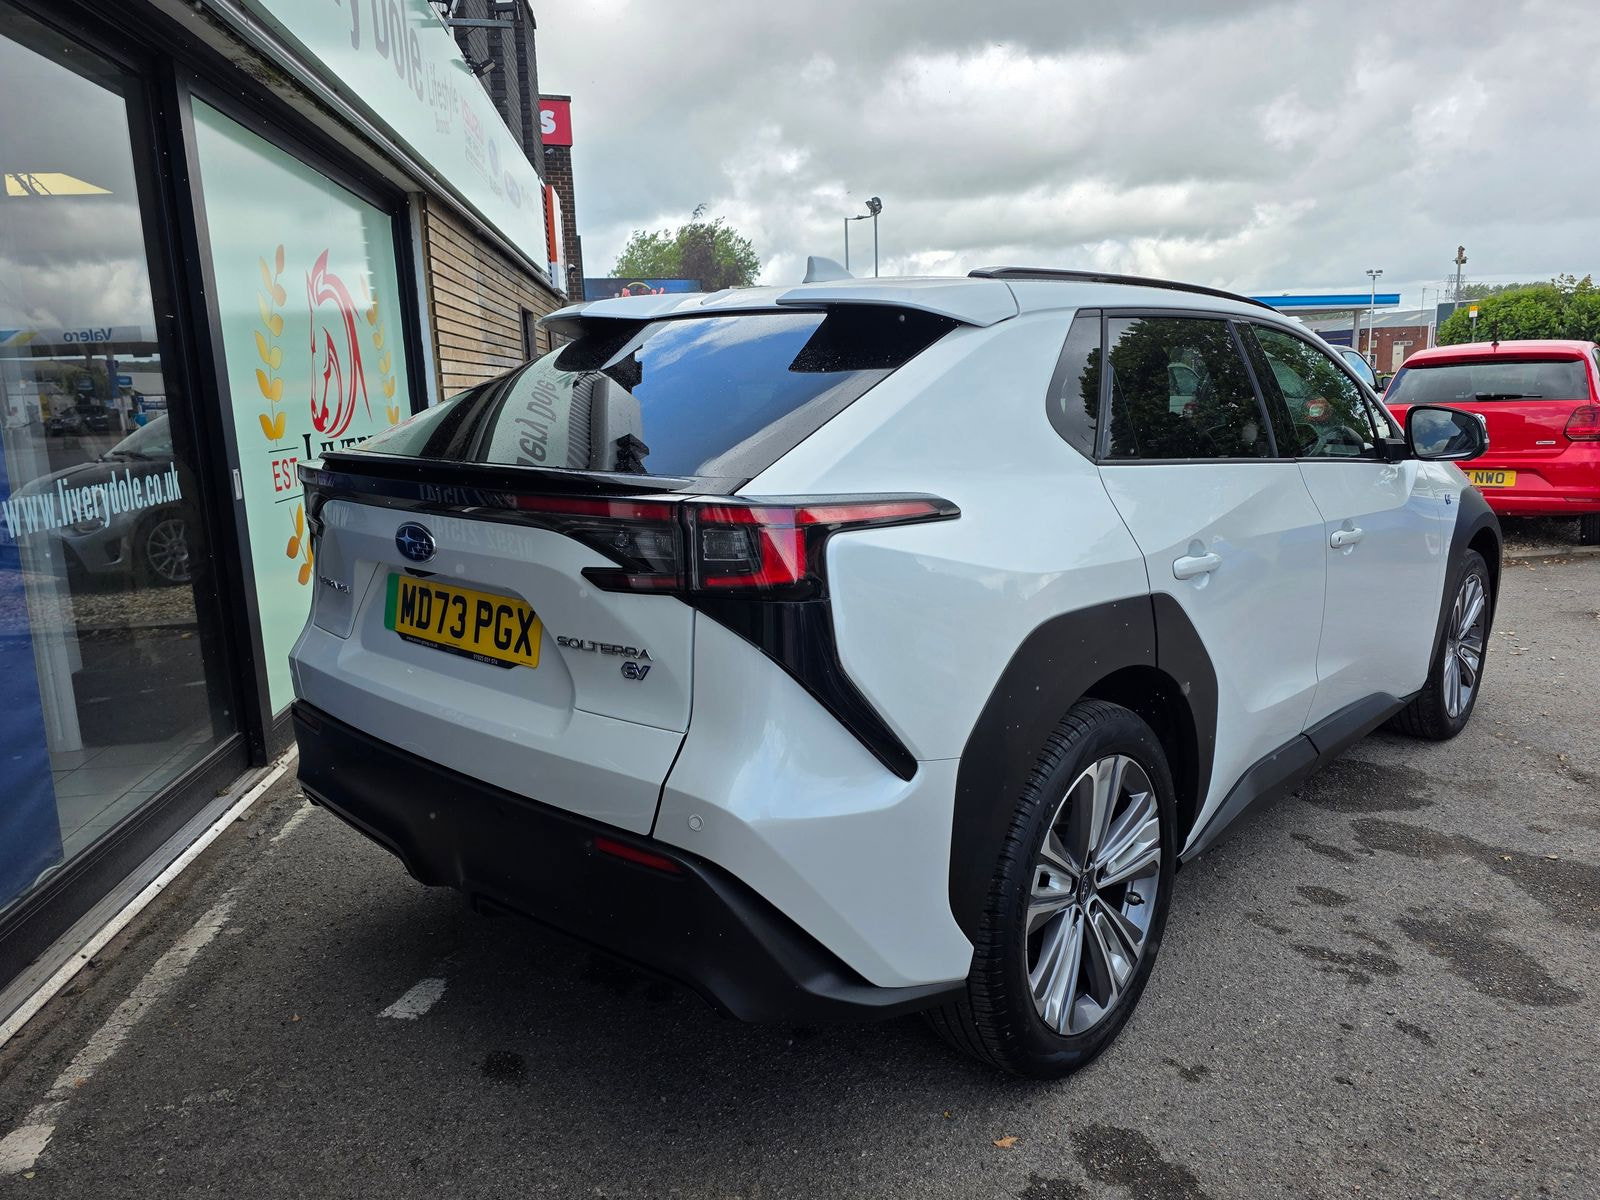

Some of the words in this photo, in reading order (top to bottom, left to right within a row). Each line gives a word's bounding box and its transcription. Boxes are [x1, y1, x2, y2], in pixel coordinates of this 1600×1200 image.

[1474, 472, 1505, 484] NWO
[2, 461, 182, 538] www.liverydole.co.uk
[400, 583, 467, 639] MD73
[474, 599, 536, 656] PGX
[557, 635, 653, 661] SOLTERRA
[621, 661, 651, 680] EV
